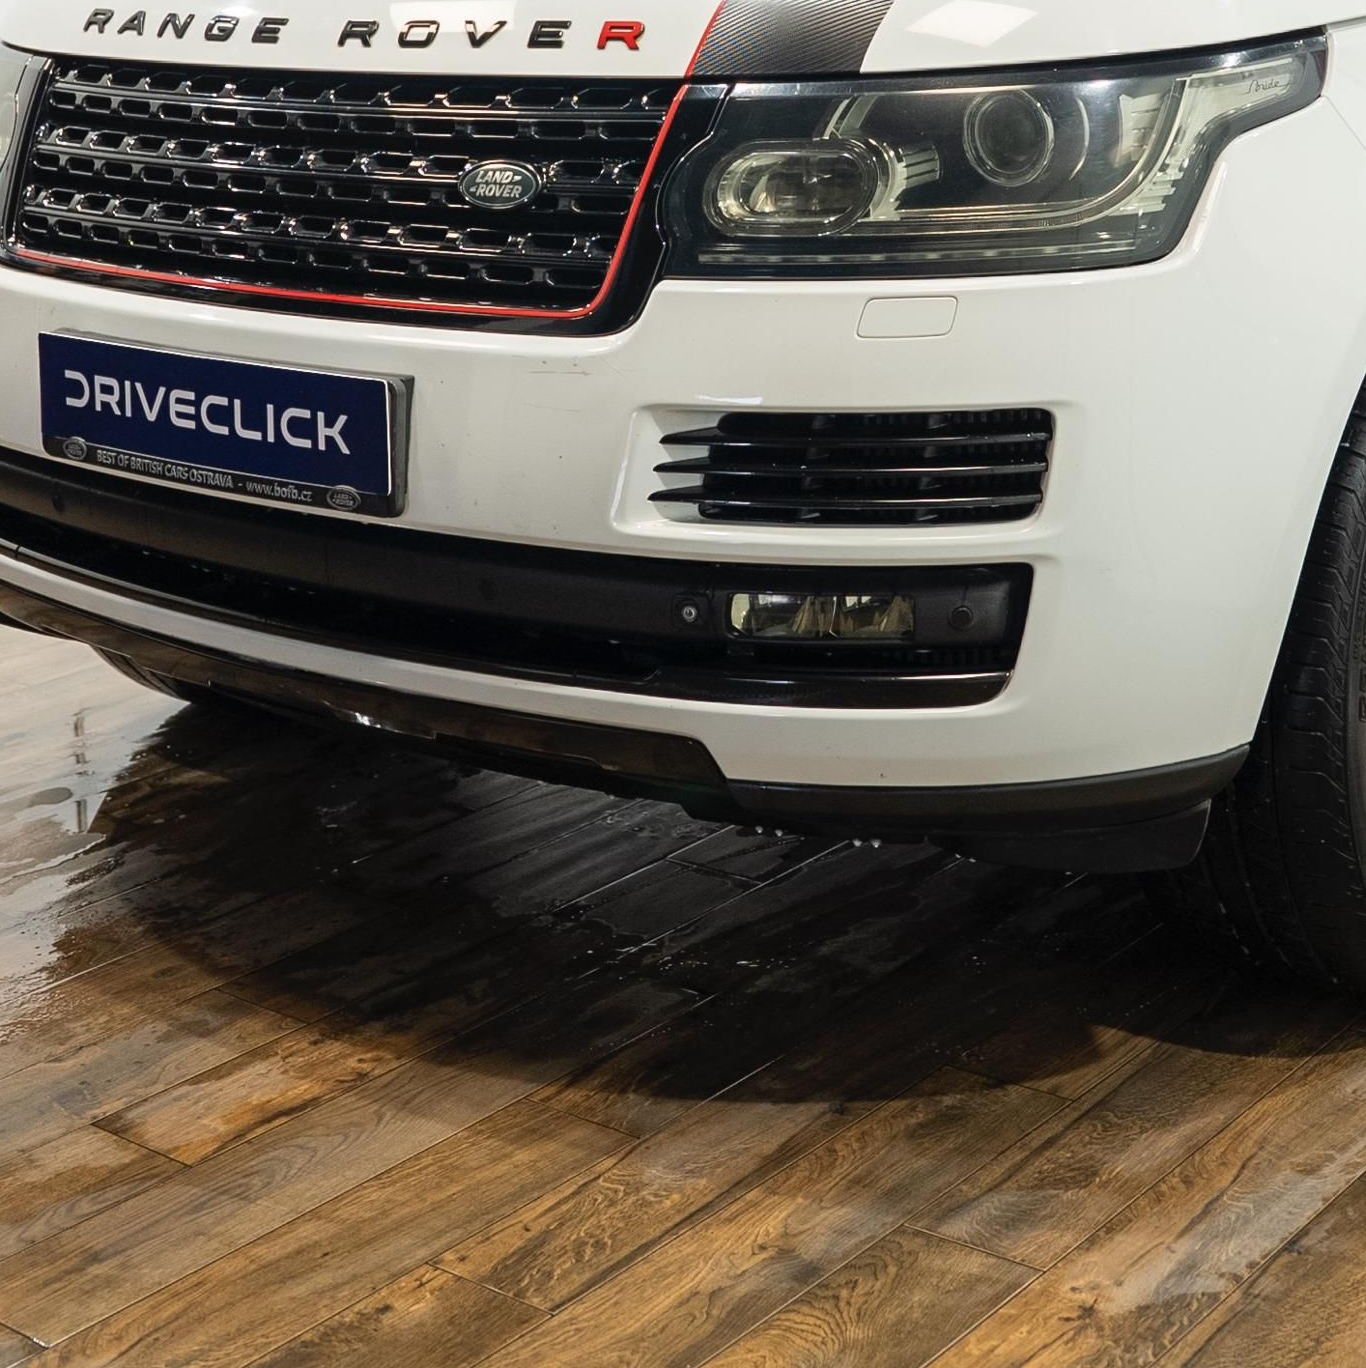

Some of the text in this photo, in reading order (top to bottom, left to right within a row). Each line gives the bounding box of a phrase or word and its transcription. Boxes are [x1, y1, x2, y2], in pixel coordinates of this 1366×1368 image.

[83, 8, 645, 50] RANGE ROVER
[476, 170, 514, 184] LAND
[476, 184, 522, 198] ROVER
[64, 369, 350, 455] DRIVECLICK
[96, 450, 117, 465] BEST
[117, 454, 130, 467] OF
[130, 457, 164, 474] BRITISH
[165, 464, 188, 479] CARS
[189, 469, 234, 488] OSTRAVA
[246, 482, 312, 502] www.bofb.cz
